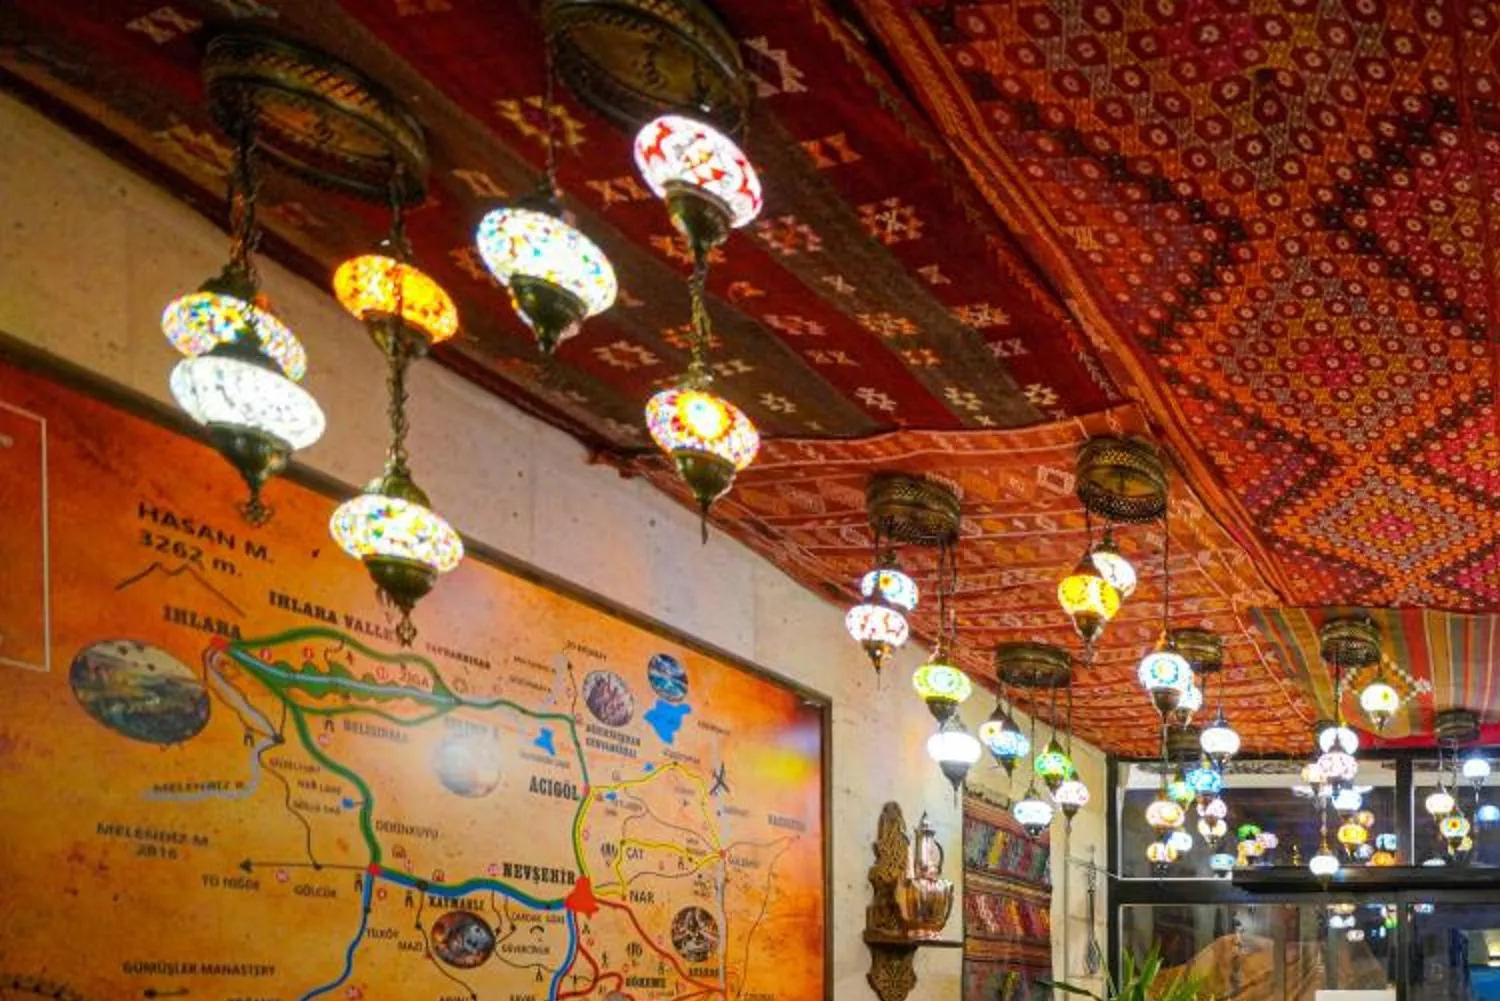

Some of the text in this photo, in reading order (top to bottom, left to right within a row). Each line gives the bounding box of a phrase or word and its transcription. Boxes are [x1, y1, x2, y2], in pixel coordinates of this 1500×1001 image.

[138, 501, 235, 550] HASAN
[141, 530, 203, 563] 3262
[163, 604, 242, 640] IHLARA
[268, 590, 398, 642] IHLARA VALLE
